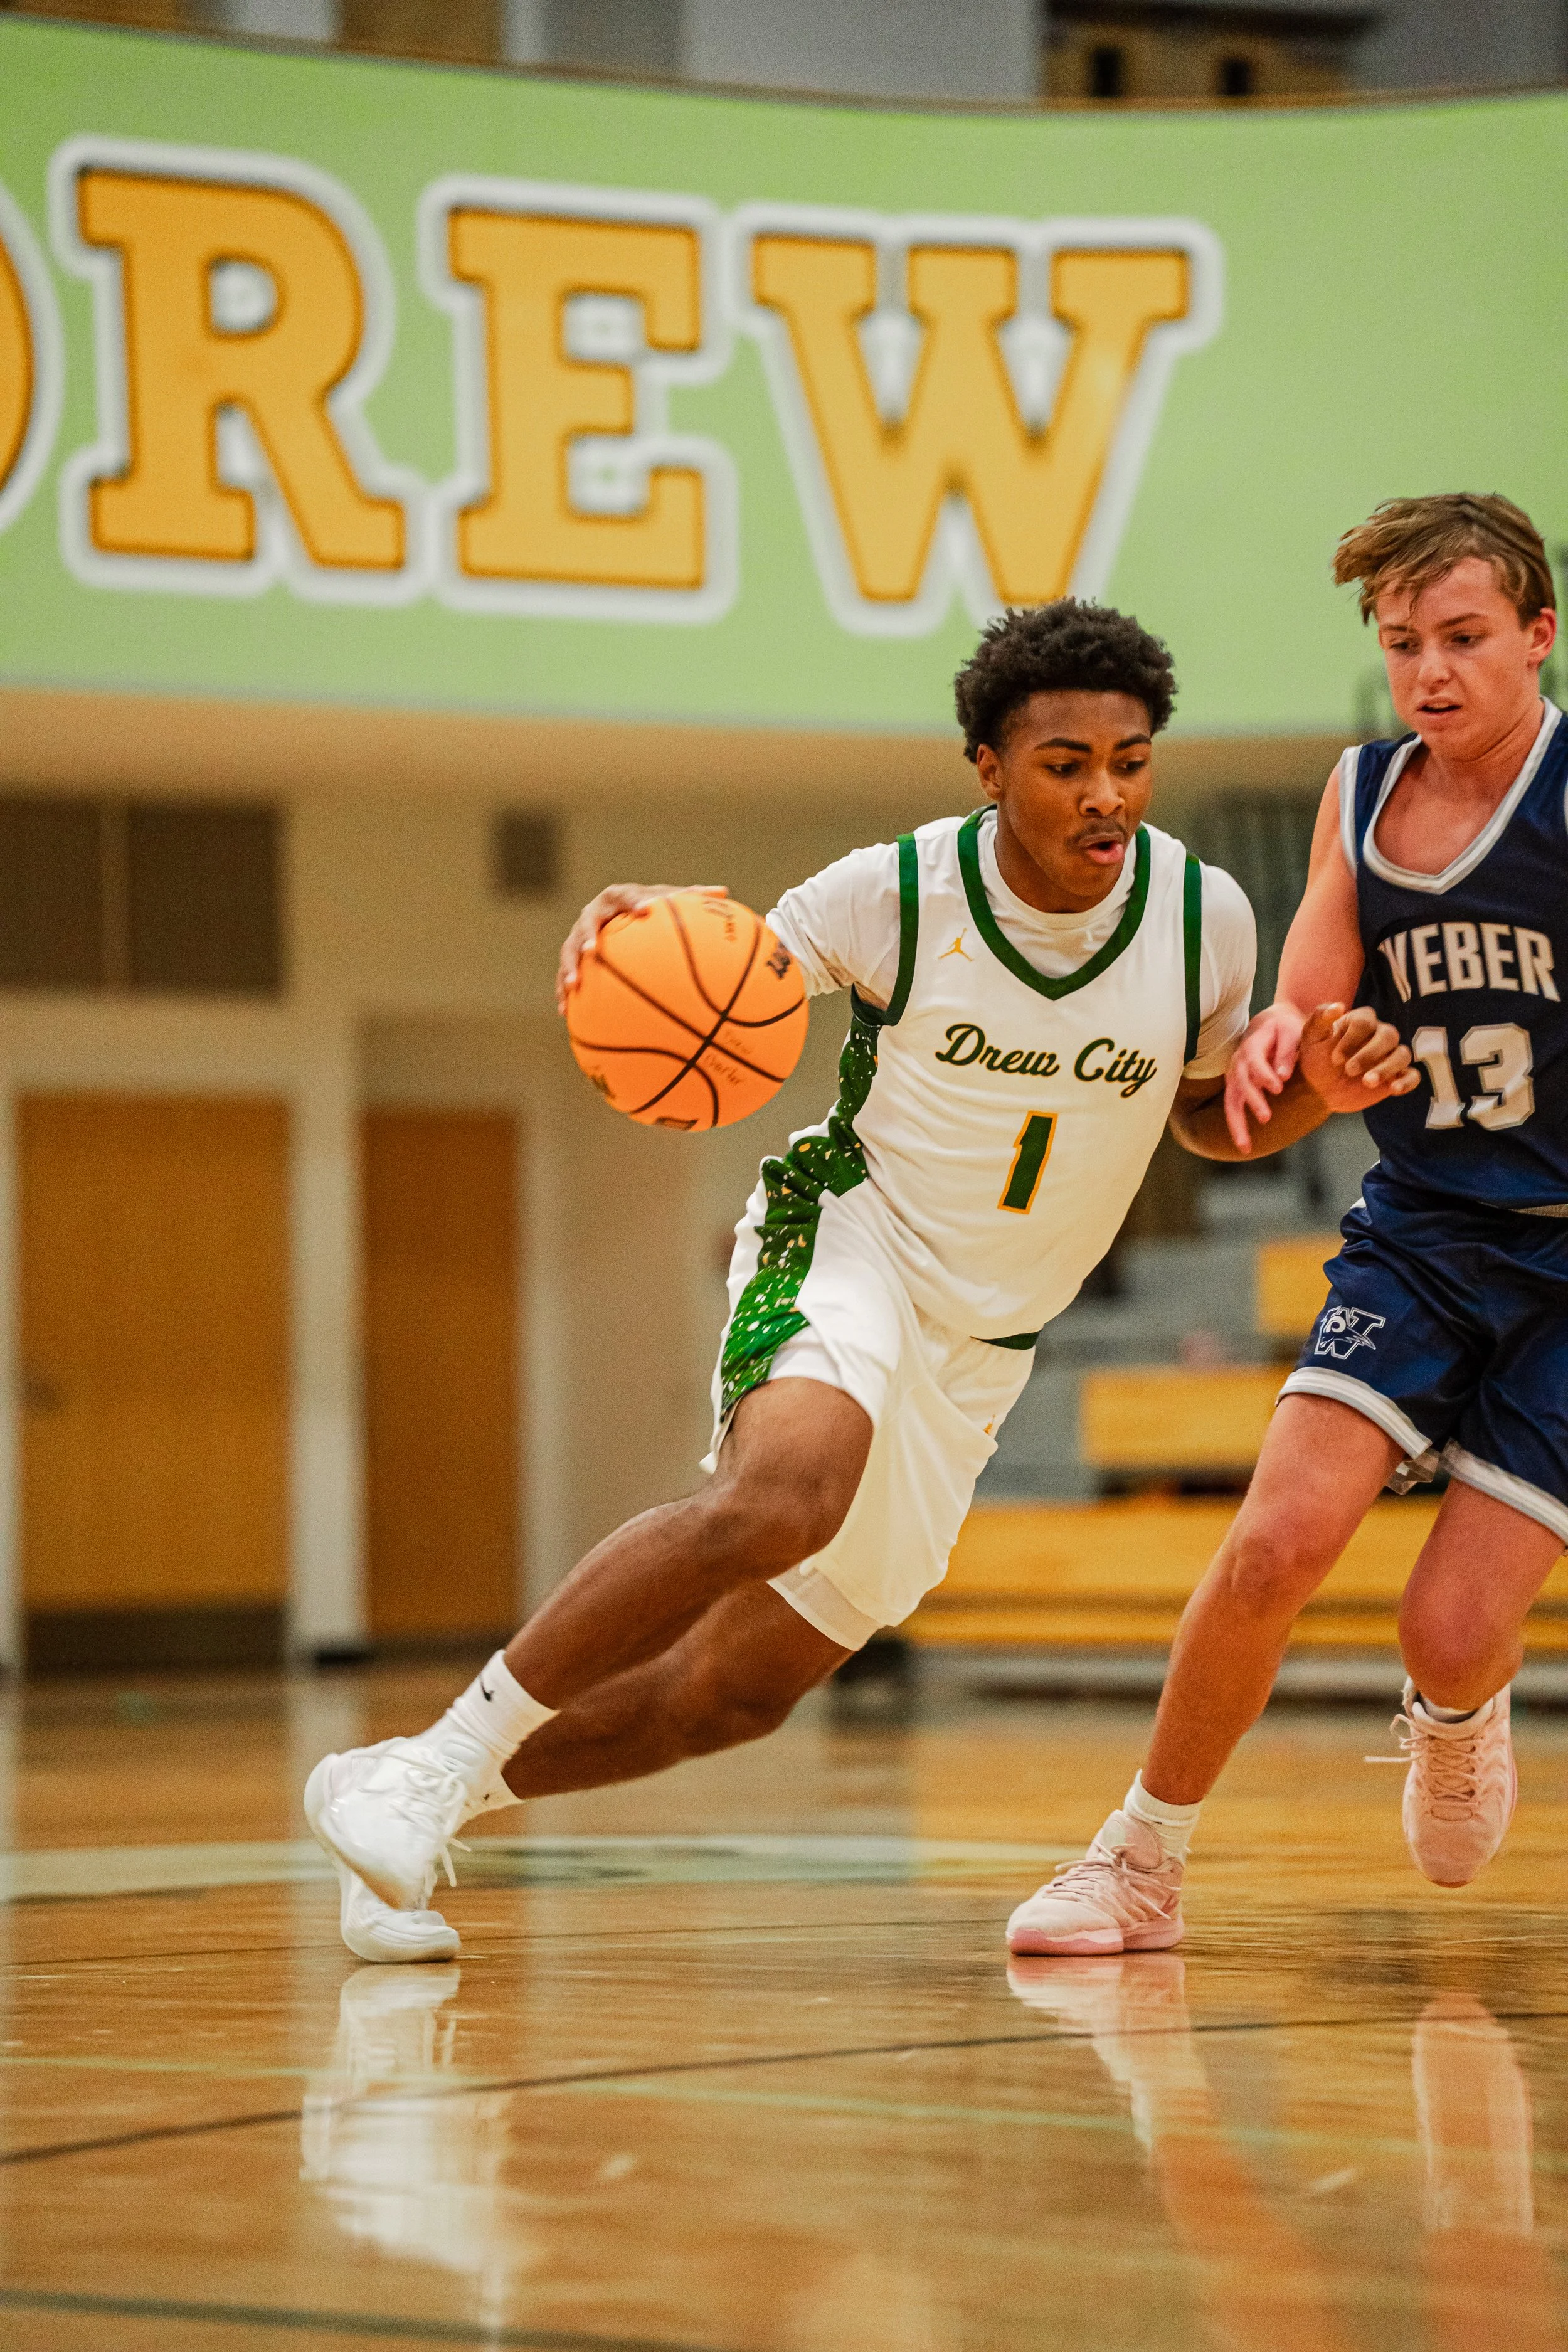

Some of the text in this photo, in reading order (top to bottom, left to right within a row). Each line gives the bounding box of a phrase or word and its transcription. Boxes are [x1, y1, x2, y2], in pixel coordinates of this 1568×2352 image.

[0, 154, 1207, 622] REW
[935, 1023, 1158, 1098] Drew City
[1411, 1022, 1536, 1131] 13
[997, 1110, 1059, 1215] 1
